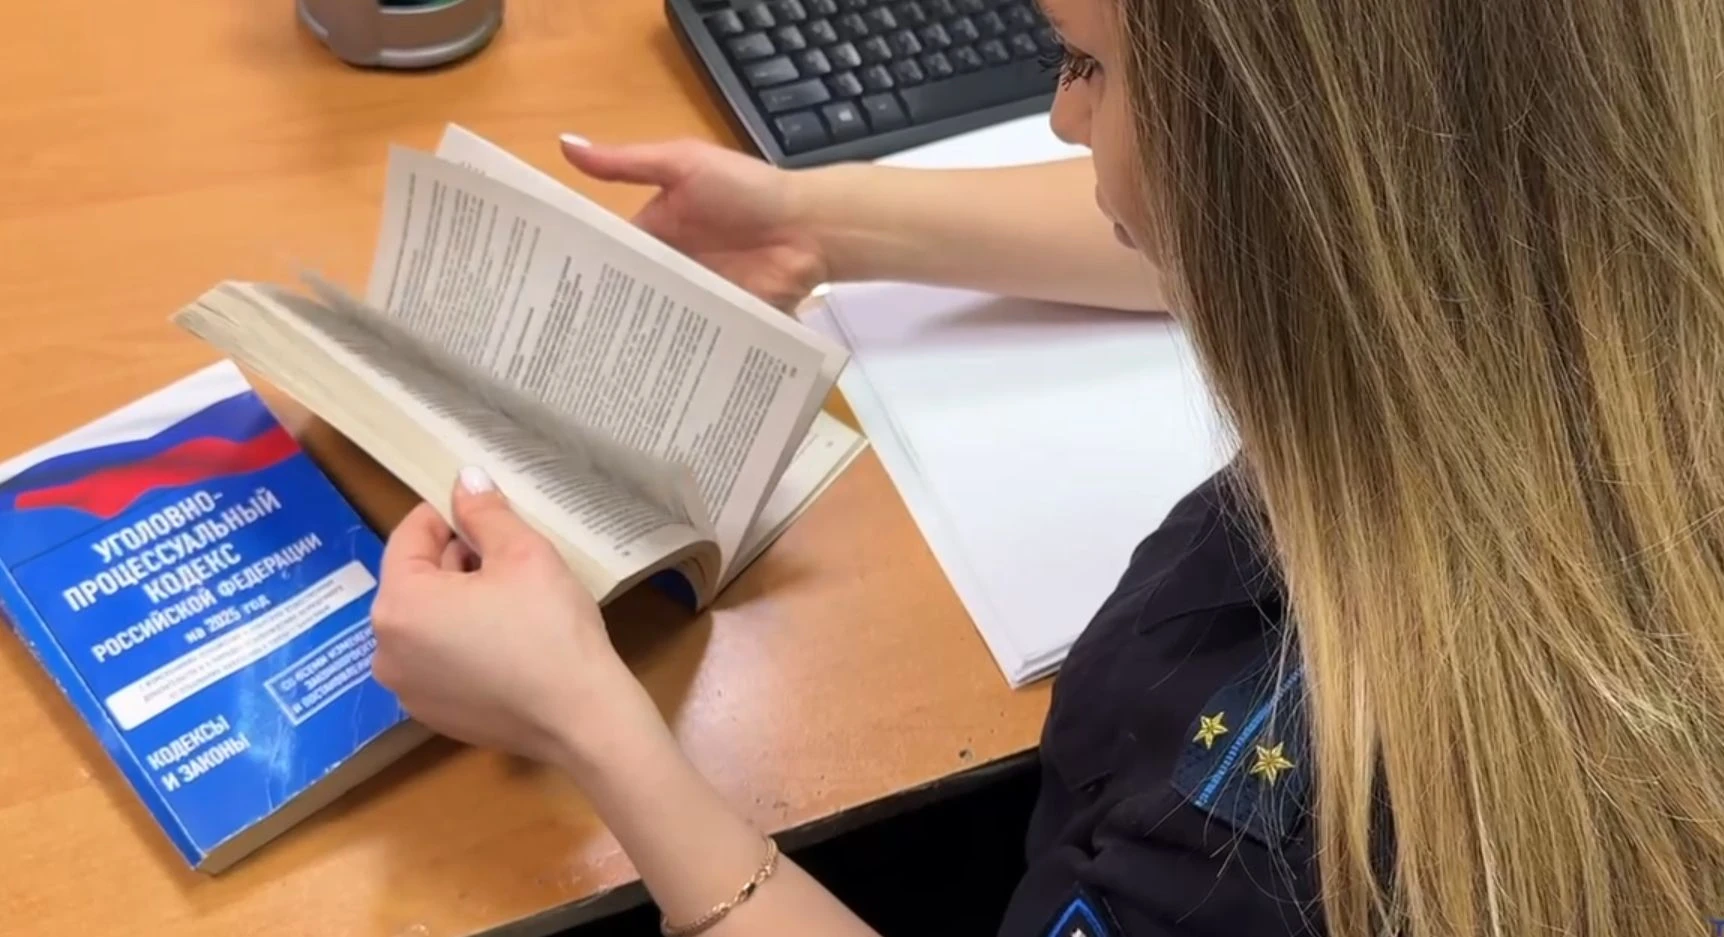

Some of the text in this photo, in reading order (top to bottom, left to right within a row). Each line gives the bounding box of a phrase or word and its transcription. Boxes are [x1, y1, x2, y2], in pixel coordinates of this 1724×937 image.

[62, 486, 282, 612] ПРОЦЕССУАЛЬНЫЙ
[91, 489, 223, 563] УГОЛОВНО-
[91, 586, 218, 663] РОССИЙСКОЙ
[217, 532, 323, 598] ФЕДЕРАЦИИ
[142, 543, 241, 604] КОДЕКС
[184, 594, 271, 644] на 2025 год
[146, 714, 230, 771] КОДЕКСЫ
[161, 731, 251, 792] И ЗАКОНЫ
